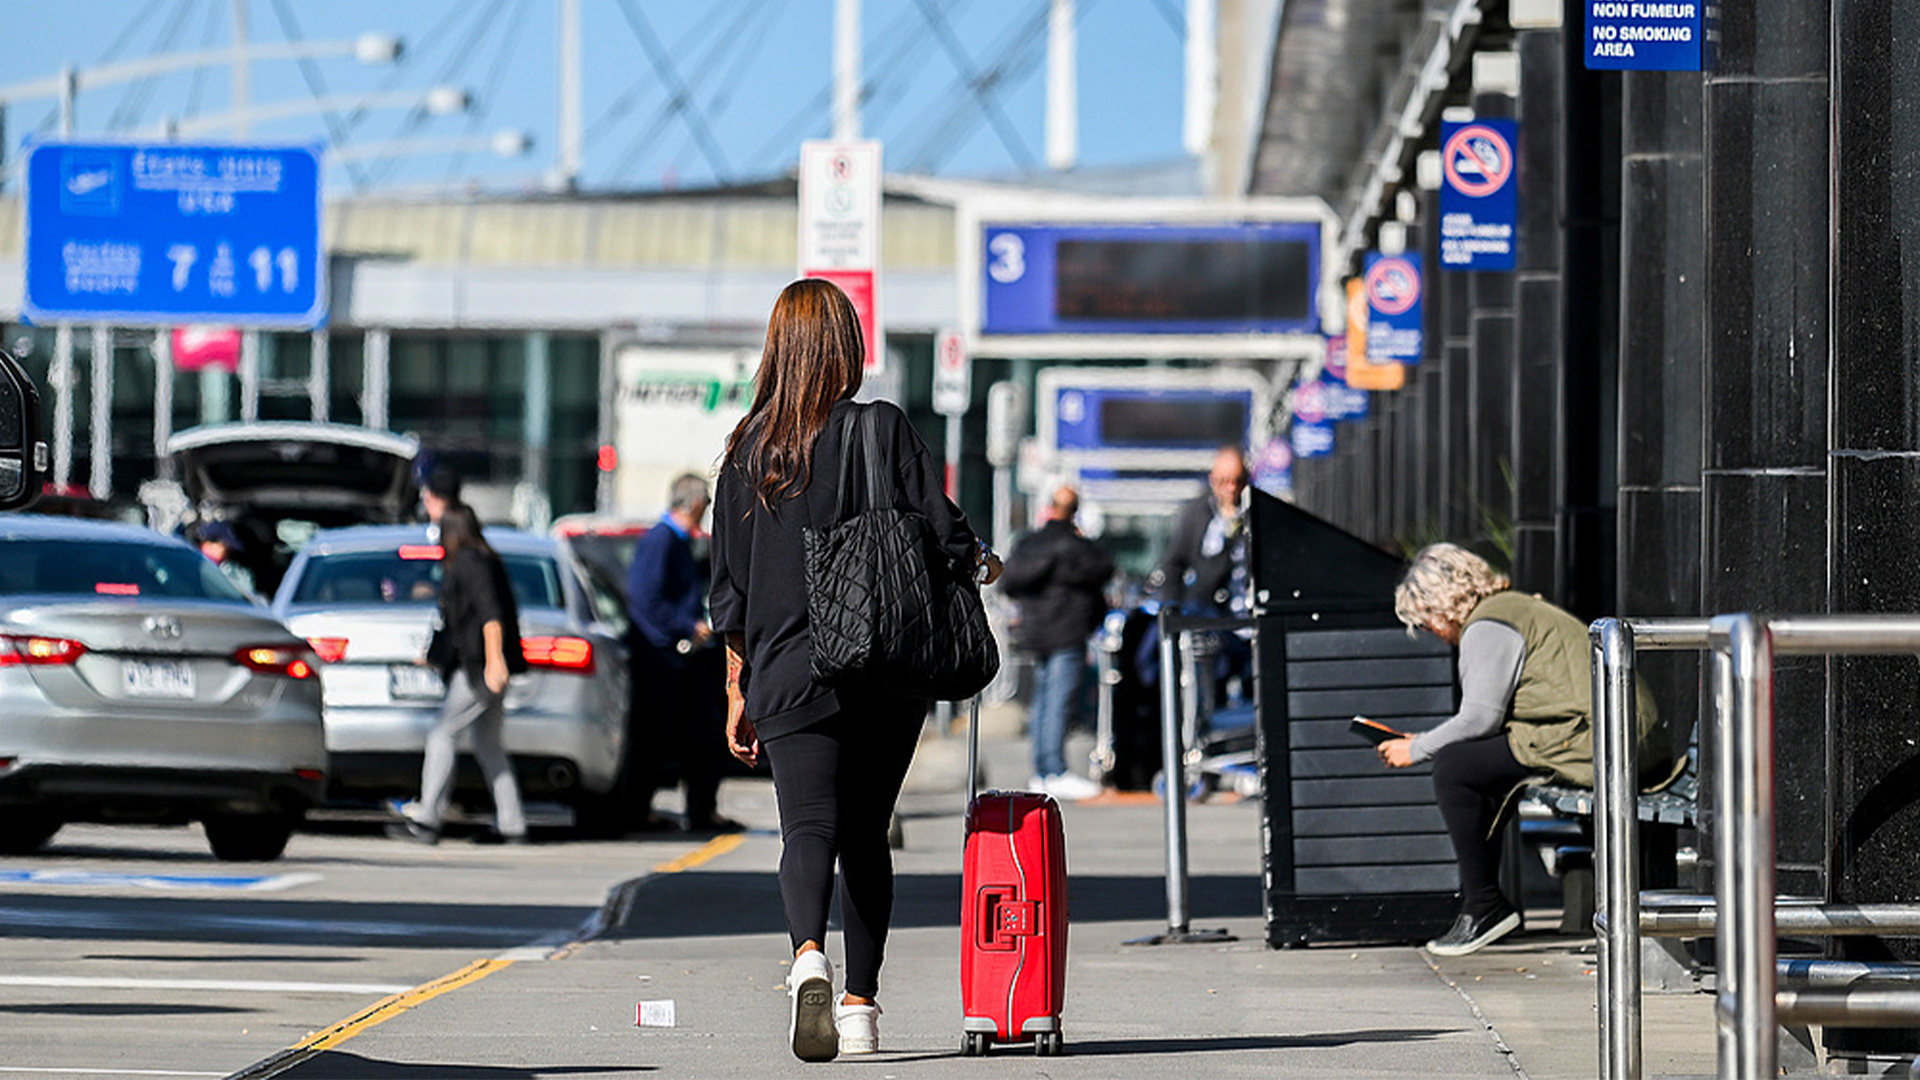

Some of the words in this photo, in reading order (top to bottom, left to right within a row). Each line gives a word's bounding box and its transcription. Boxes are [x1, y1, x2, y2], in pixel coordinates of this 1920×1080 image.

[1593, 4, 1628, 18] NON
[1631, 4, 1695, 18] FUMEUR
[1593, 26, 1617, 40] NO
[1619, 26, 1692, 41] SMOKING
[1593, 43, 1635, 57] AREA
[988, 233, 1025, 283] 3
[167, 244, 197, 292] 7
[249, 246, 299, 294] 11
